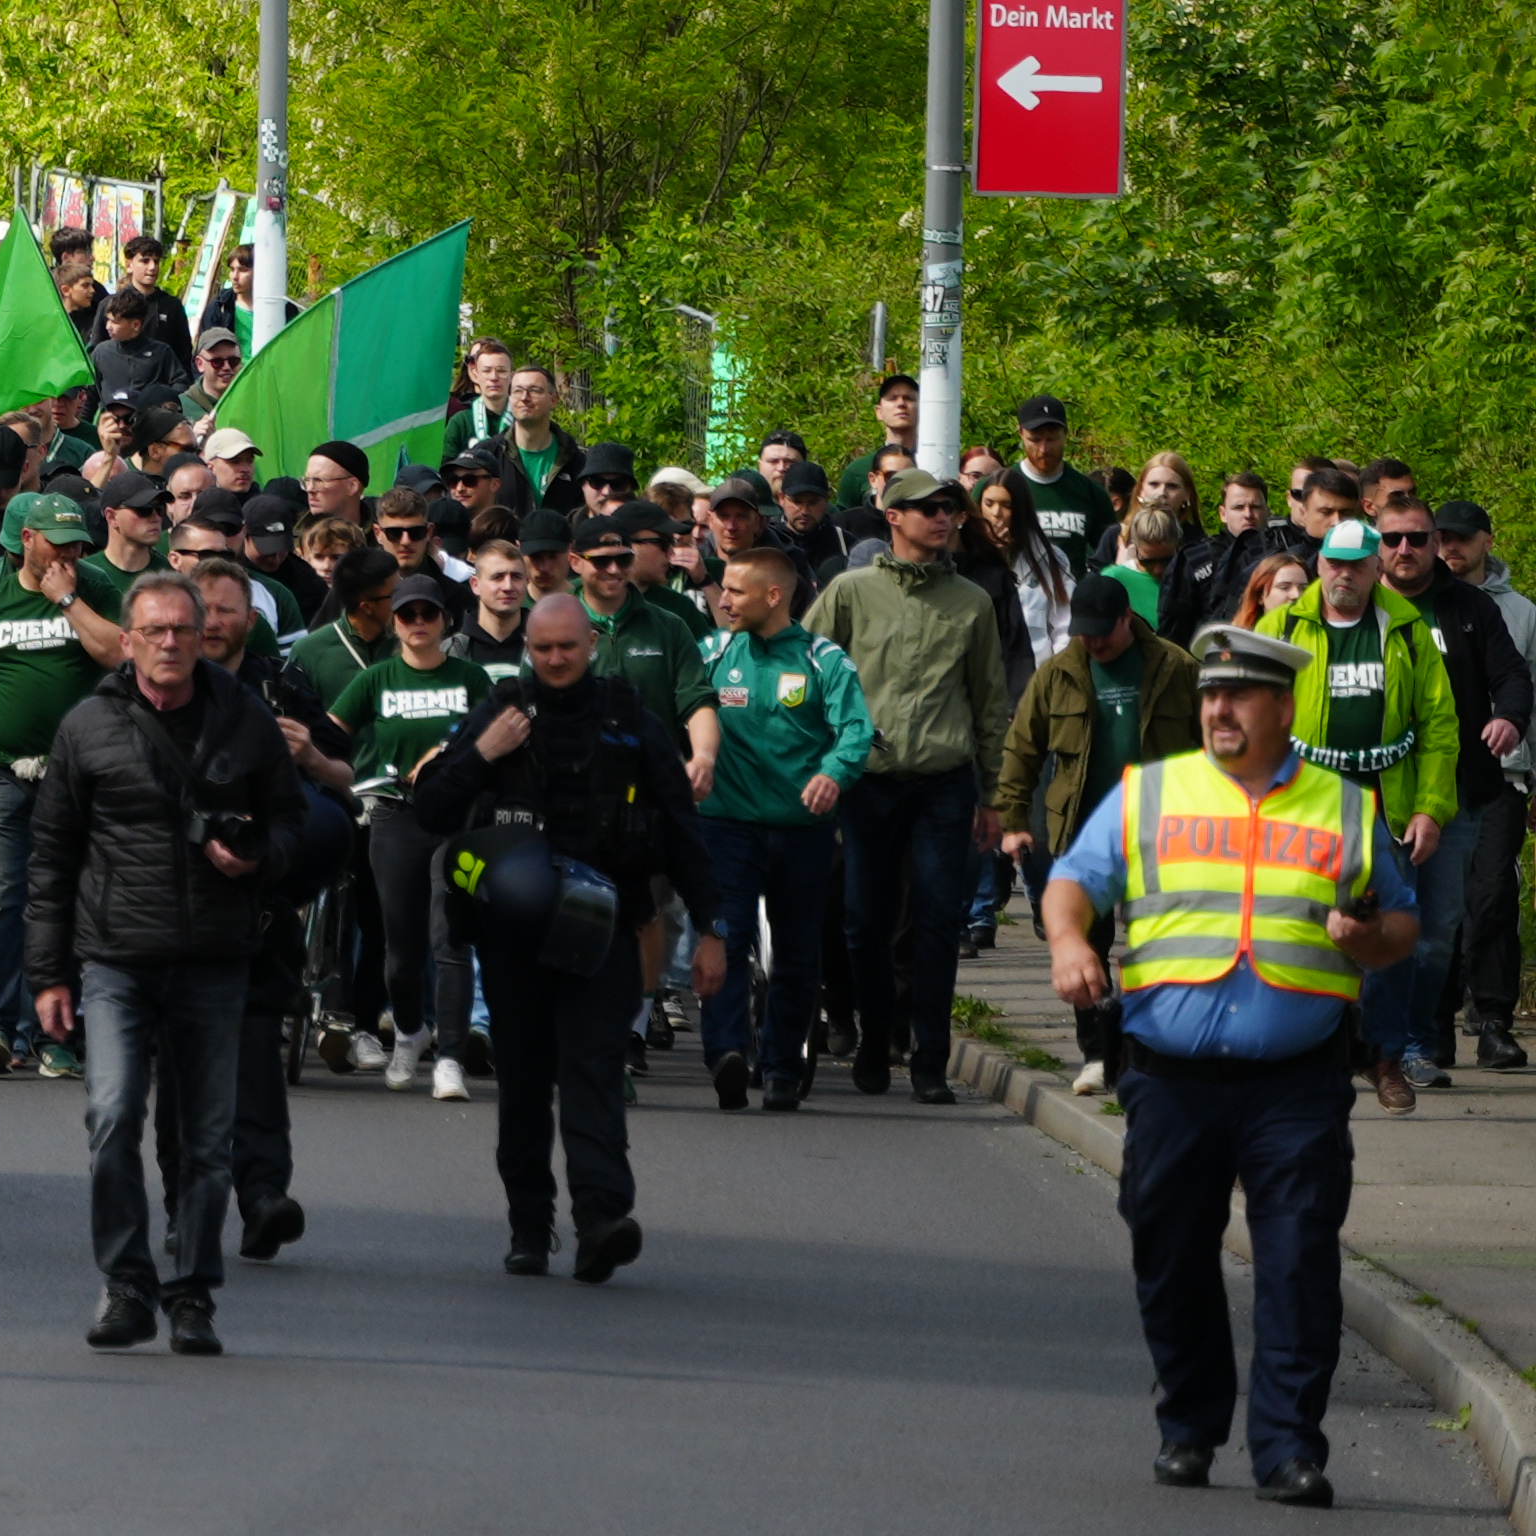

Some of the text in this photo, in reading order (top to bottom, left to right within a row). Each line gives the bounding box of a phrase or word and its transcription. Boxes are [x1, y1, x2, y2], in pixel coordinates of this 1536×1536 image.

[990, 3, 1114, 30] Dein Markt
[381, 685, 469, 718] CHEMIE
[1160, 816, 1338, 873] POLIZEI
